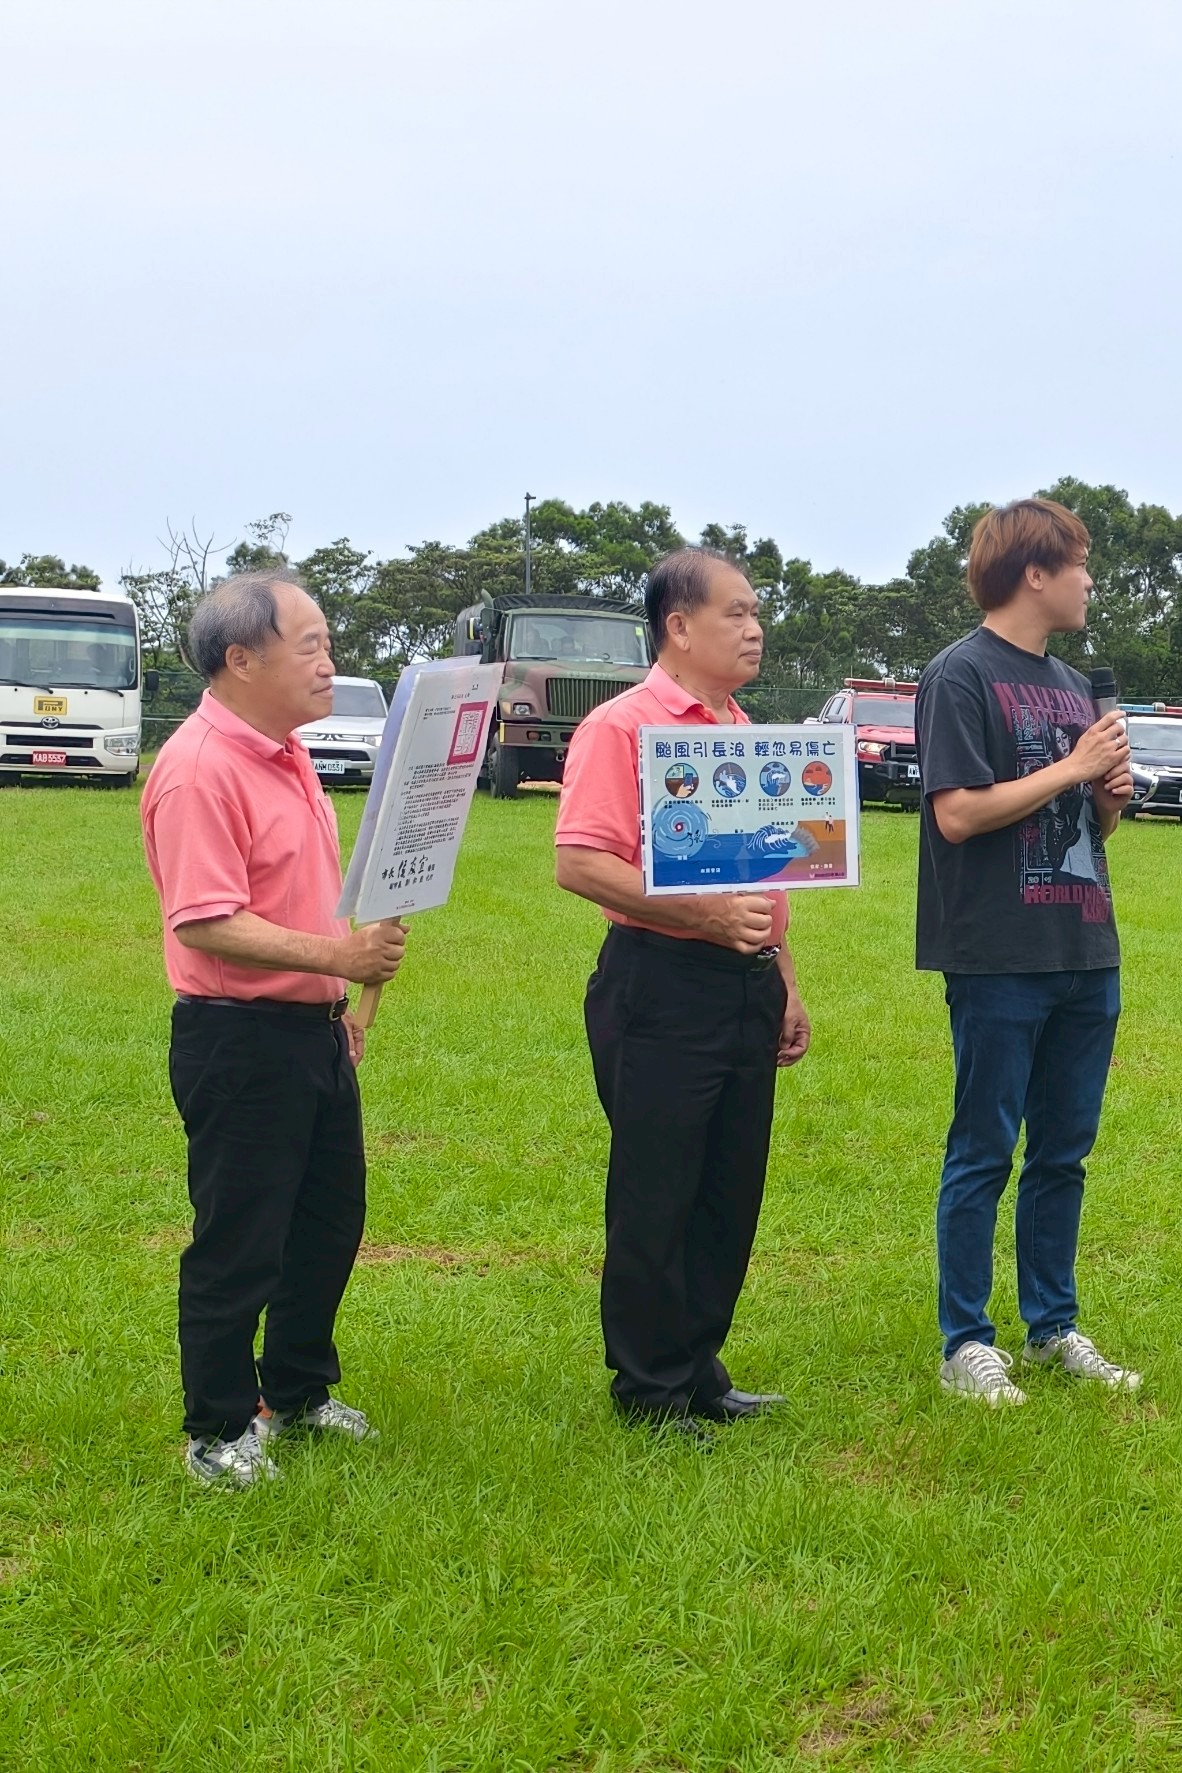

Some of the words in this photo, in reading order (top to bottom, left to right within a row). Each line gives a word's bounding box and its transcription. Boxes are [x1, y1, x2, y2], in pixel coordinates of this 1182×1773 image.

[656, 741, 745, 758] 颱風引長浪
[754, 740, 836, 757] 輕忽易傷亡
